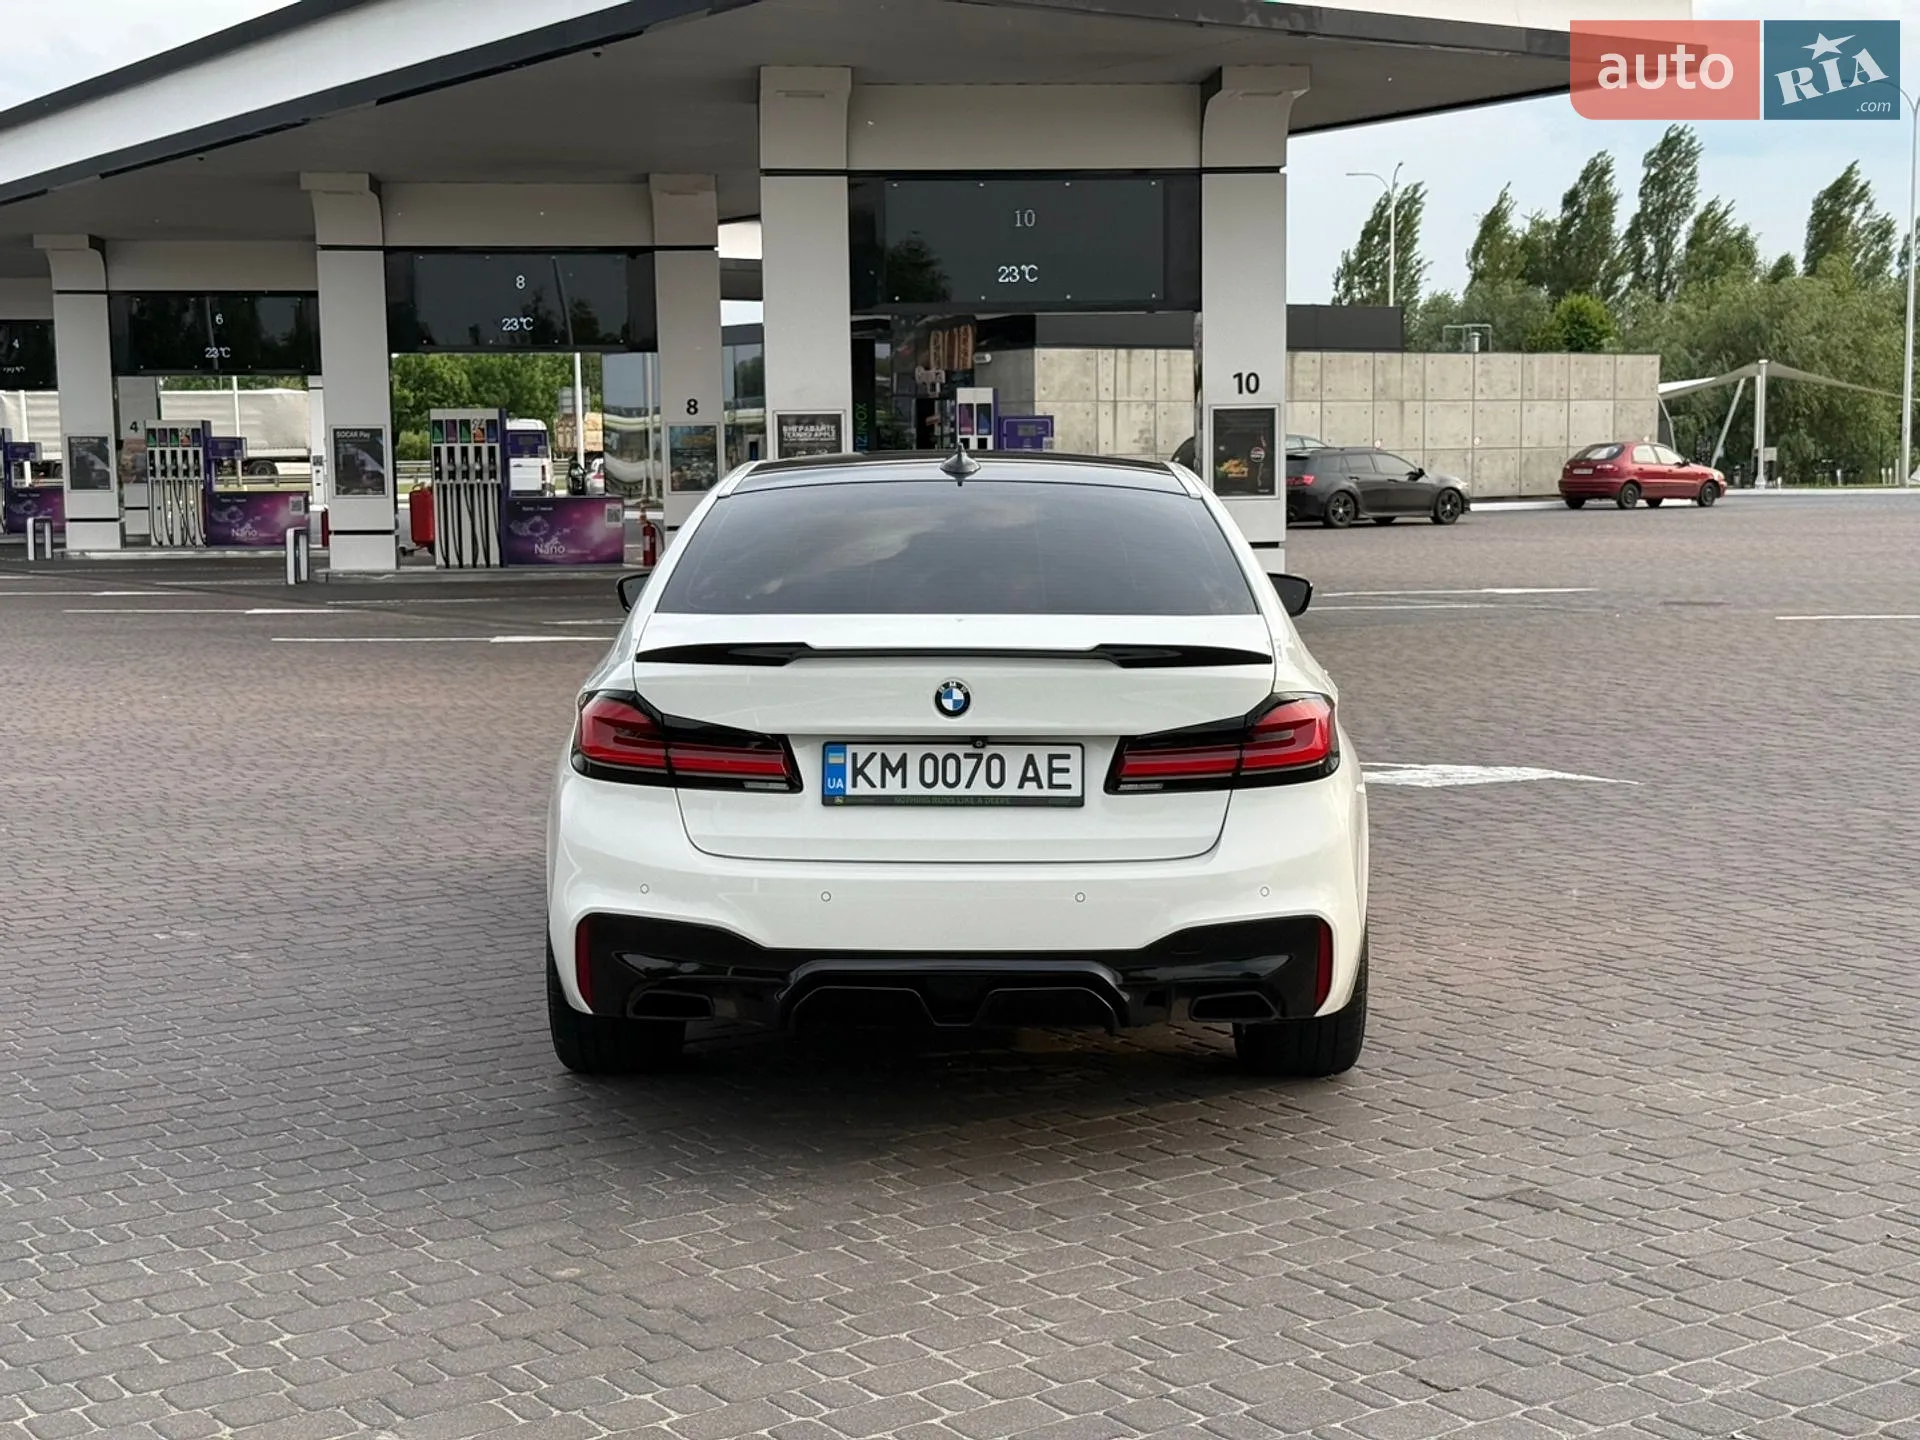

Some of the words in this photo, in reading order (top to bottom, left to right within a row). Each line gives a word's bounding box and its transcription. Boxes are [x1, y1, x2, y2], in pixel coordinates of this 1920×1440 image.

[1015, 209, 1036, 227] 10
[515, 275, 526, 290] 8
[215, 313, 224, 325] 6
[1233, 372, 1260, 395] 10
[686, 398, 699, 416] 8
[129, 421, 139, 433] 4
[231, 528, 258, 537] Nano
[534, 543, 566, 554] Nano
[851, 752, 908, 789] KM
[918, 752, 1006, 790] 0070
[1017, 753, 1072, 790] AE
[827, 778, 844, 790] UA
